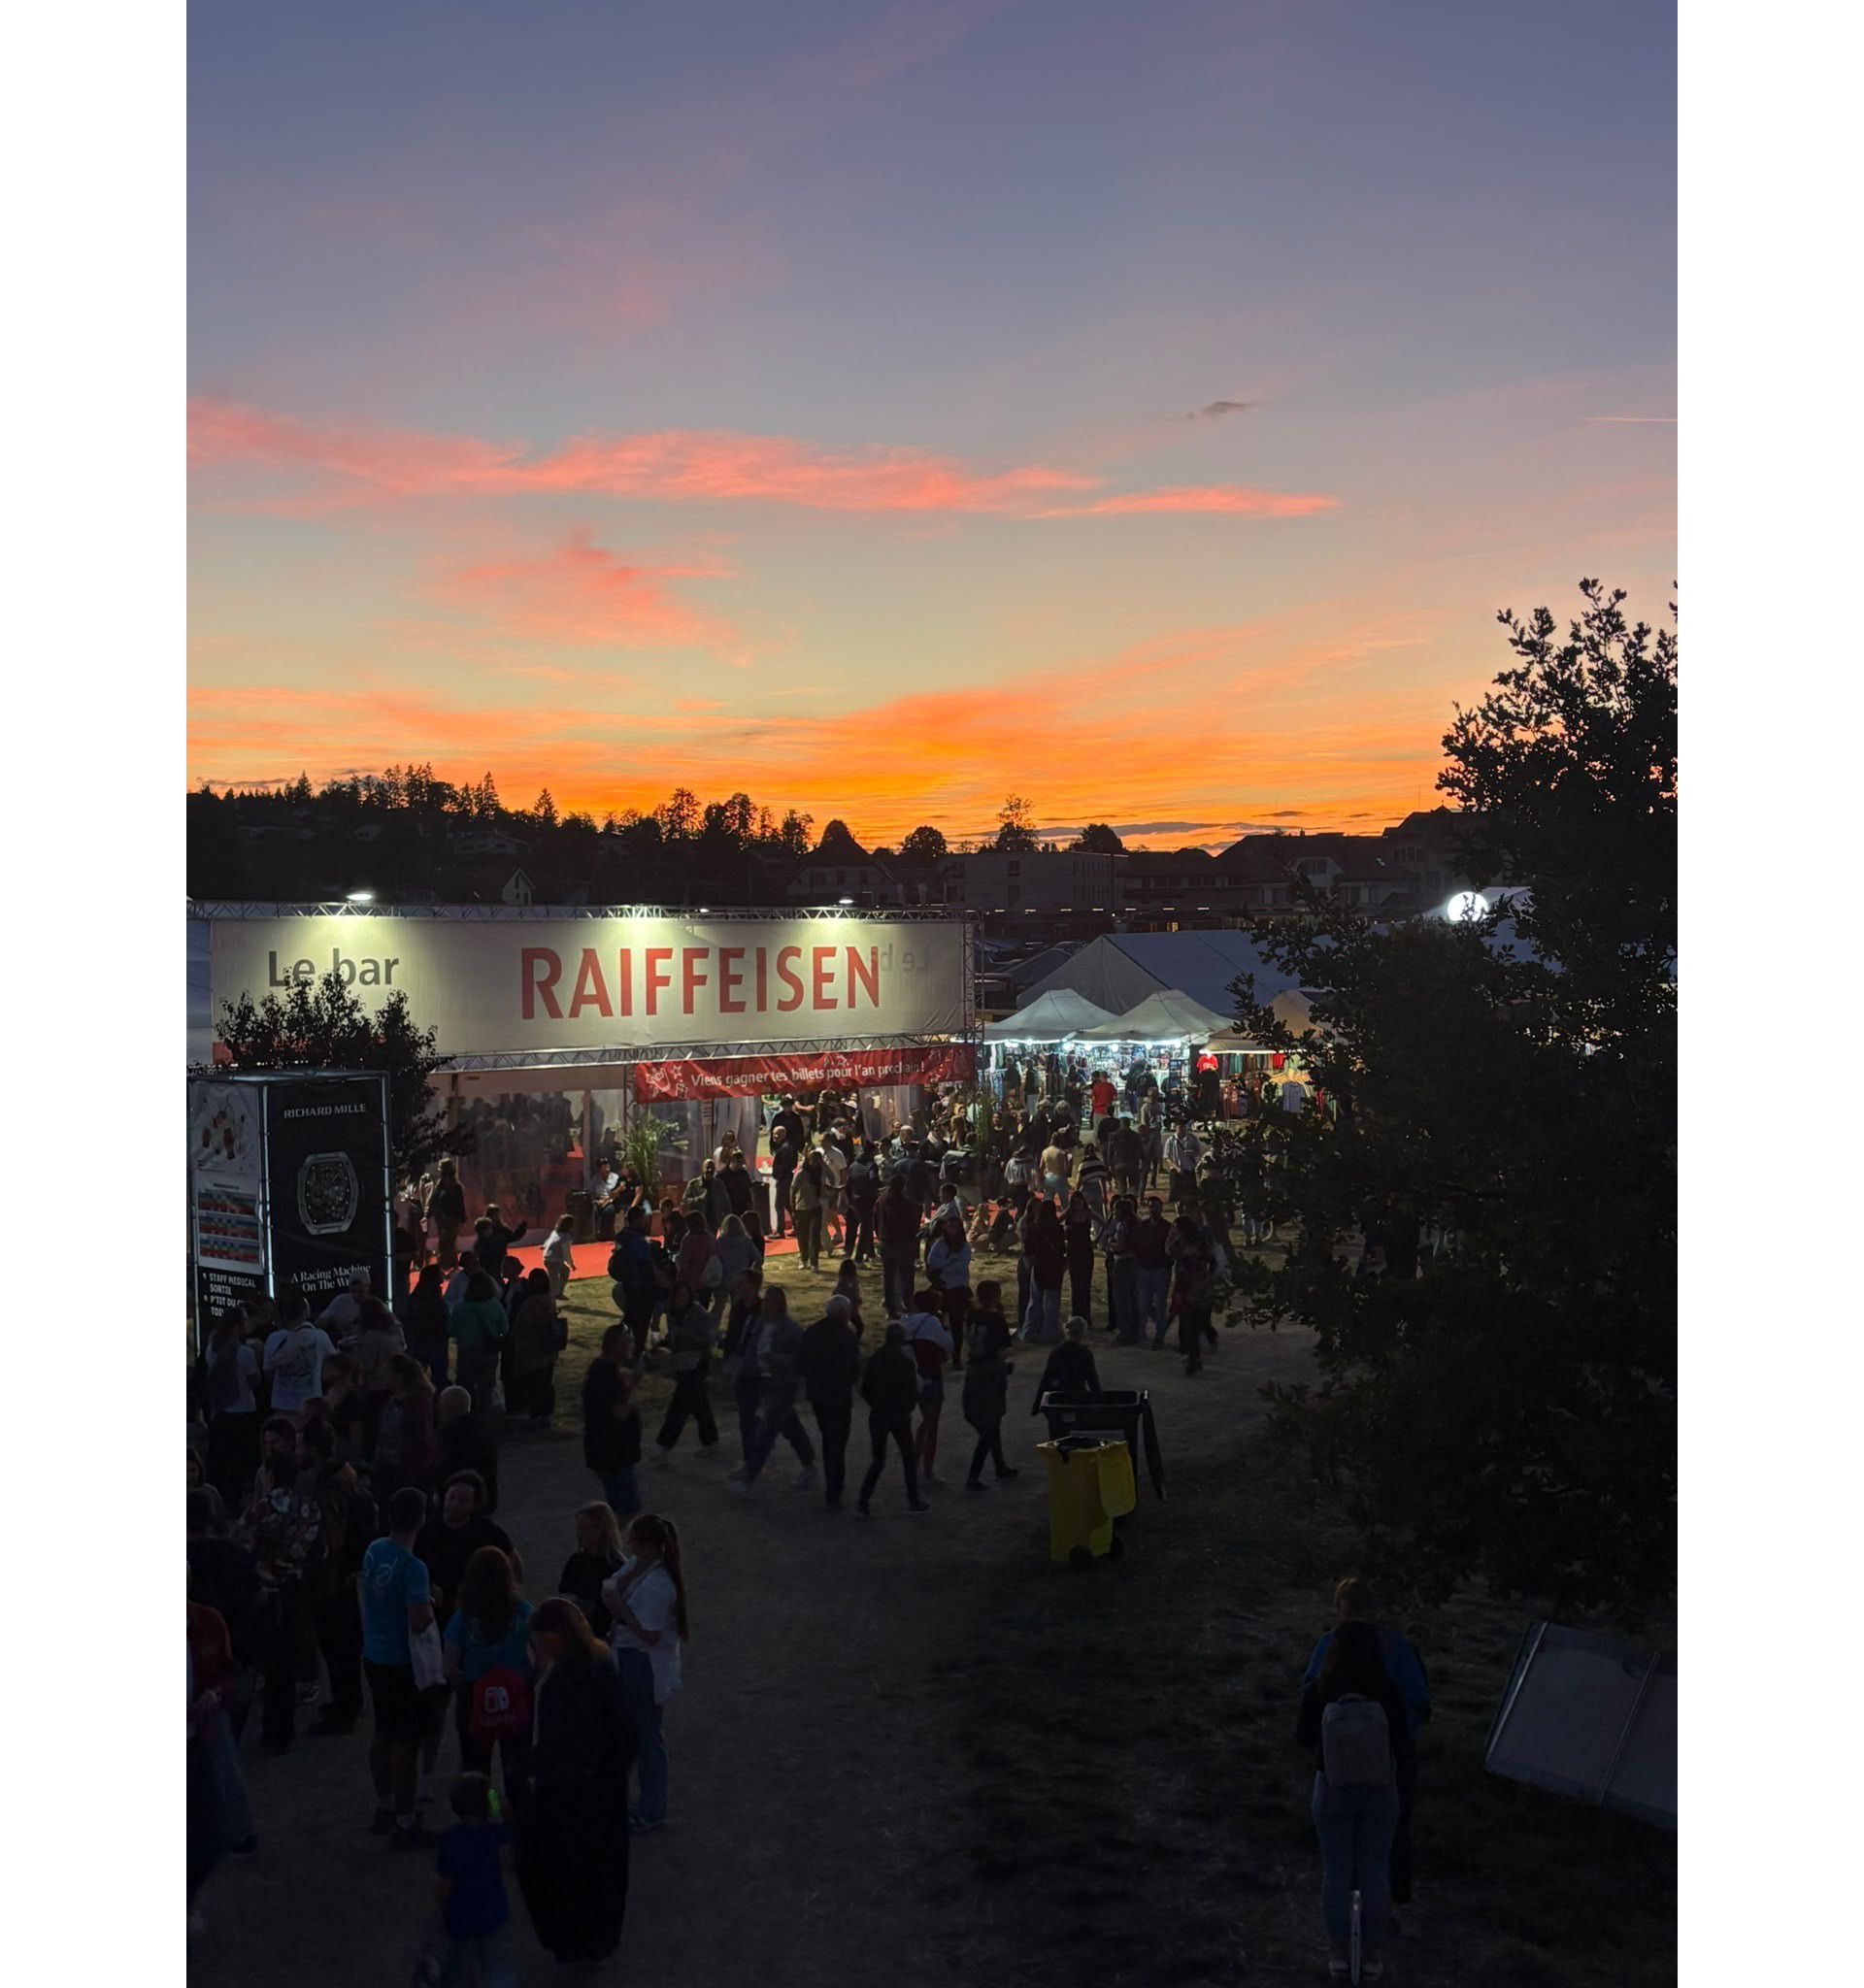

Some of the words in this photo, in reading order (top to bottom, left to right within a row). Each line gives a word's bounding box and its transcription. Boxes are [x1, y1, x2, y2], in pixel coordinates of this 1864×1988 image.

[269, 950, 316, 988] Le
[332, 947, 400, 987] bar
[521, 945, 880, 1020] RAIFFEISEN
[691, 1073, 722, 1087] Viens
[726, 1072, 768, 1088] gagner
[771, 1071, 788, 1082] tes
[791, 1066, 824, 1081] billets
[826, 1068, 852, 1080] pour
[283, 1105, 332, 1118] RICHARD
[334, 1103, 366, 1114] MILLE
[300, 1269, 332, 1282] Racing
[302, 1281, 316, 1292] On
[318, 1278, 335, 1290] The
